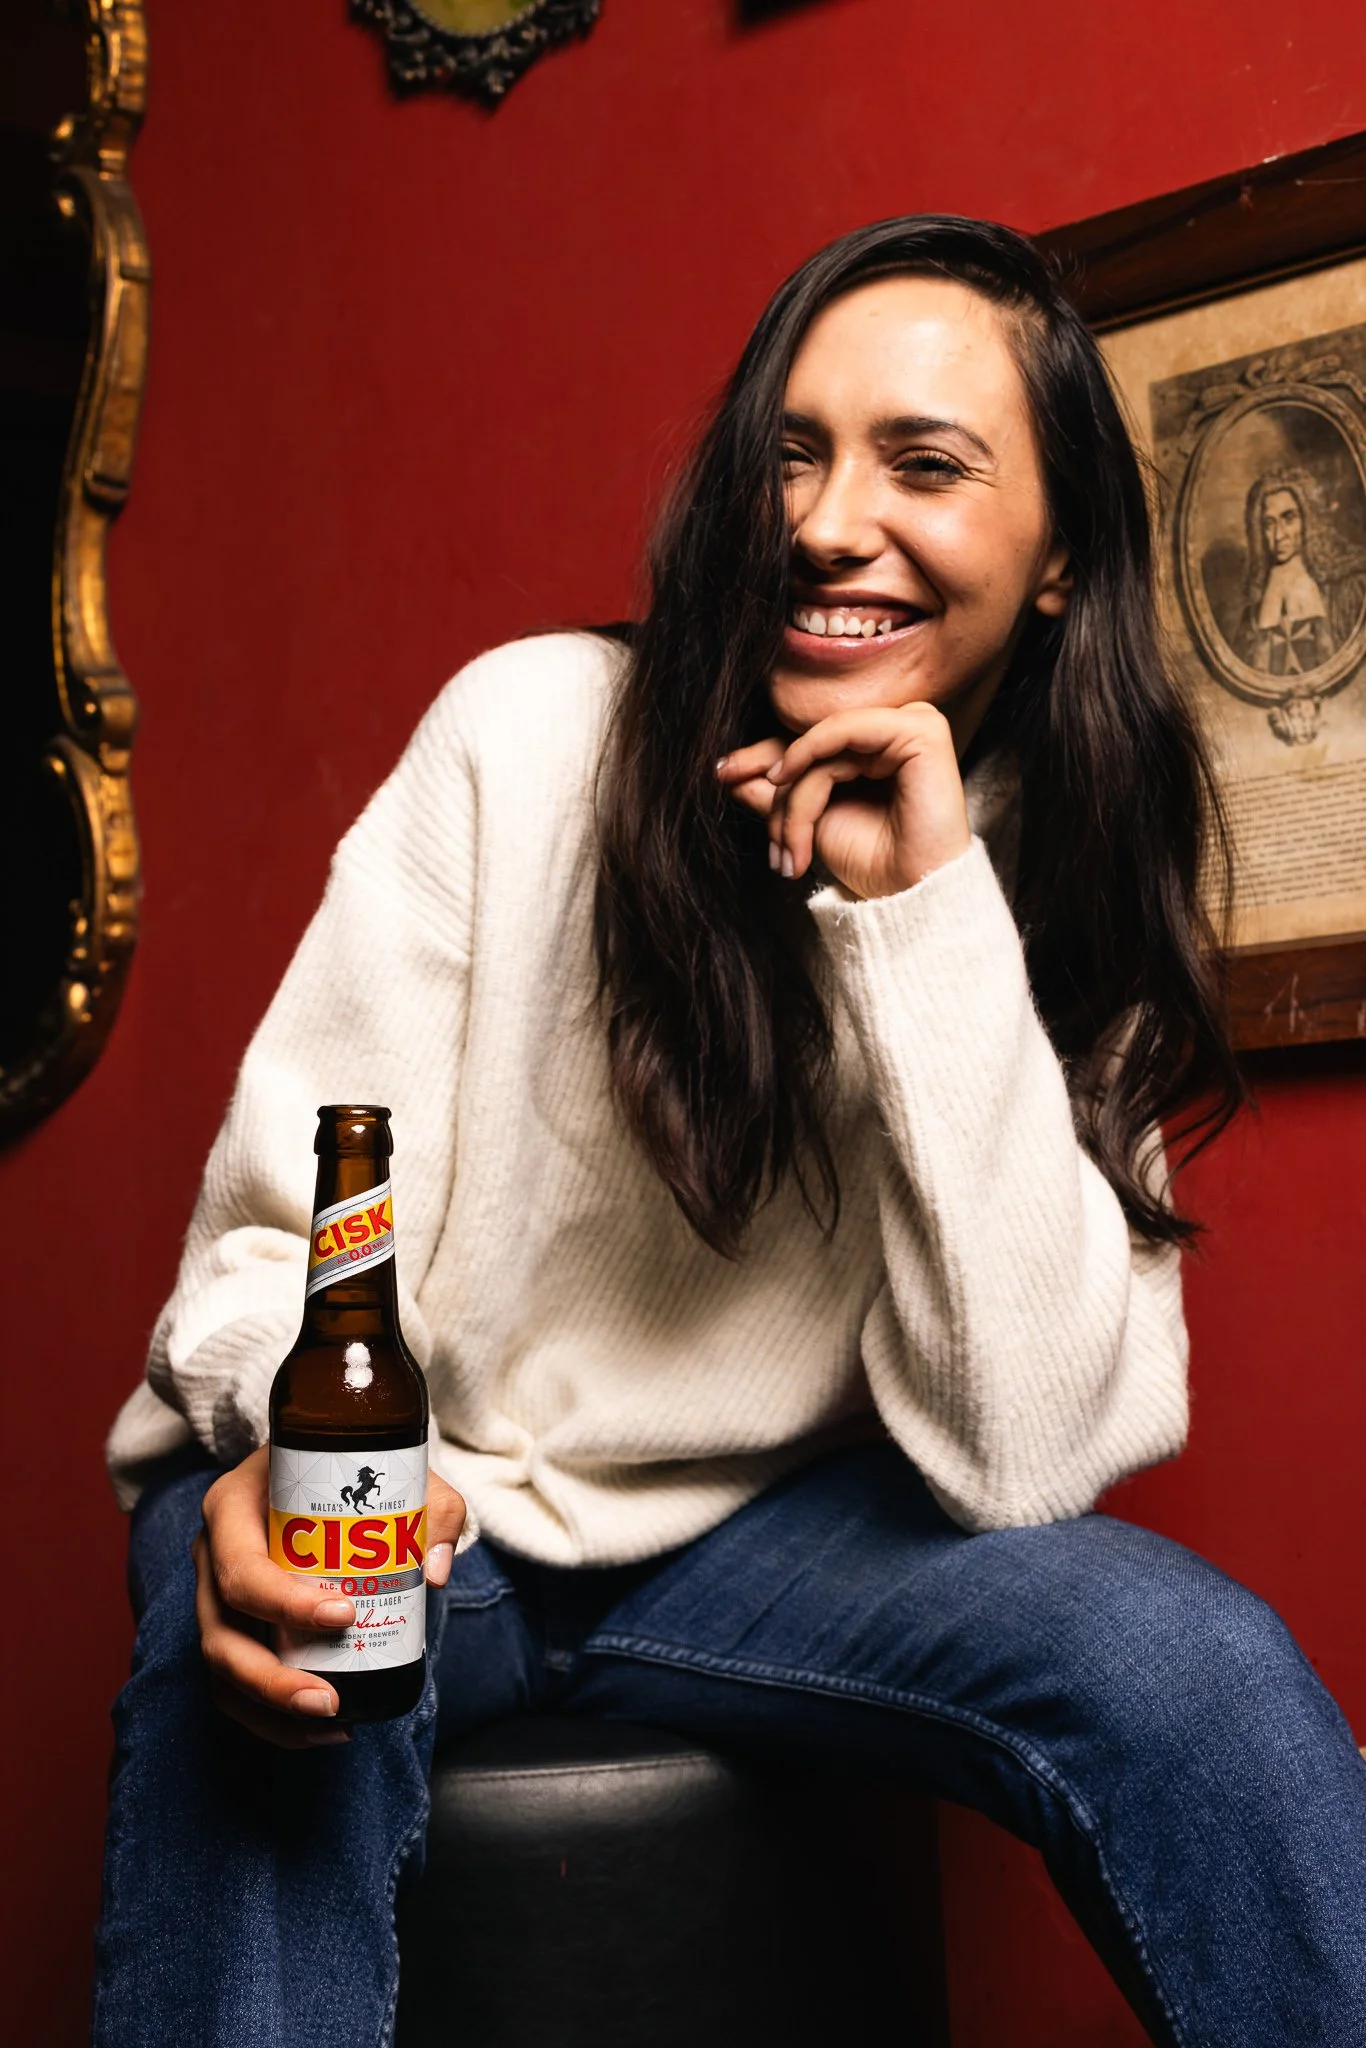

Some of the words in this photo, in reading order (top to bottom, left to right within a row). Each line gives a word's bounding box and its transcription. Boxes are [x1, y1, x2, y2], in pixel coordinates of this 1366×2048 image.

[314, 1201, 392, 1258] CISK
[350, 1244, 371, 1261] 0.0
[311, 1502, 343, 1512] MALTA'S
[379, 1500, 406, 1510] FINEST
[282, 1510, 425, 1571] CISK
[320, 1582, 338, 1590] ALC.
[341, 1576, 379, 1596] 0.0
[355, 1599, 375, 1608] FREE
[379, 1596, 402, 1607] LAGER
[368, 1630, 399, 1638] BREWERS
